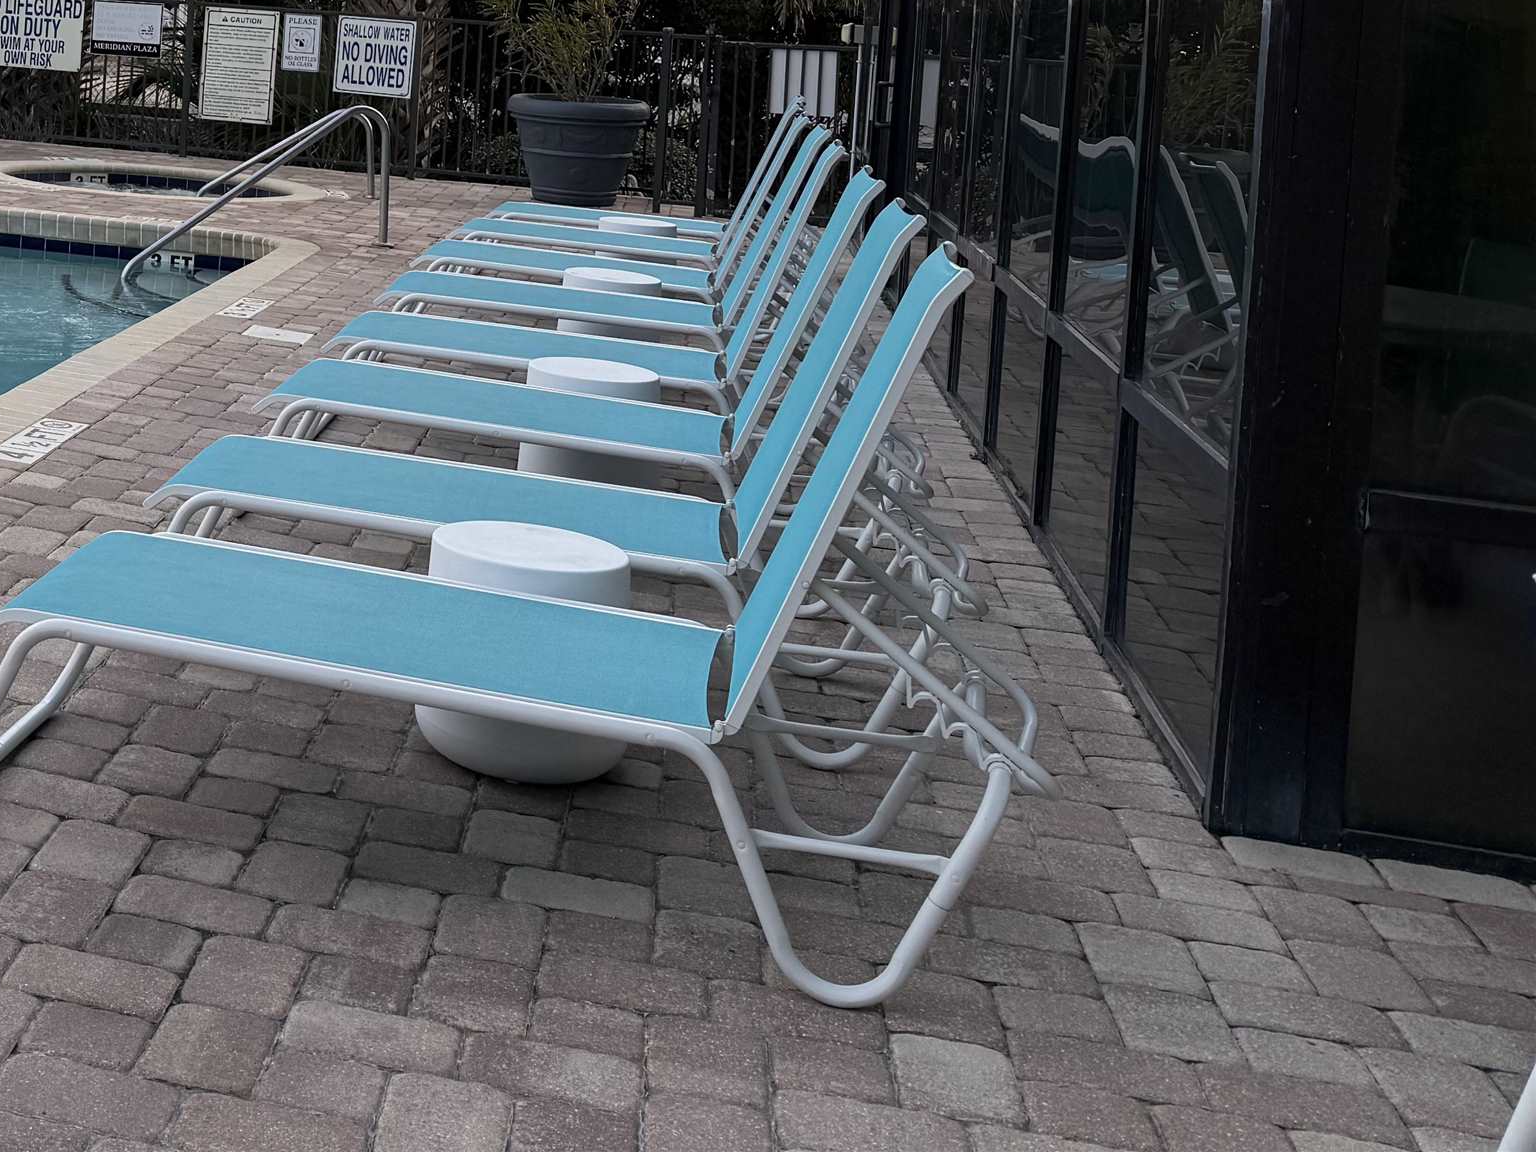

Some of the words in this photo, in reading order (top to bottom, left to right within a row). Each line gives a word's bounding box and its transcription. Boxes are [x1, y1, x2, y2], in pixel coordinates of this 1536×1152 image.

[0, 15, 19, 36] ON
[24, 17, 61, 38] DUTY
[230, 16, 262, 24] CAUTION
[288, 17, 319, 25] PLEASE
[343, 23, 381, 39] SHALLOW
[384, 27, 410, 42] WATER
[24, 37, 36, 51] AT
[38, 38, 64, 54] YOUR
[93, 42, 132, 51] MERIDIAN
[133, 44, 158, 53] PLAZA
[342, 41, 360, 61] NO
[365, 43, 408, 66] DIVING
[4, 50, 26, 65] OWN
[29, 51, 52, 67] RISK
[341, 64, 404, 88] ALLOWED
[0, 450, 34, 459] 4
[24, 428, 65, 441] FT
